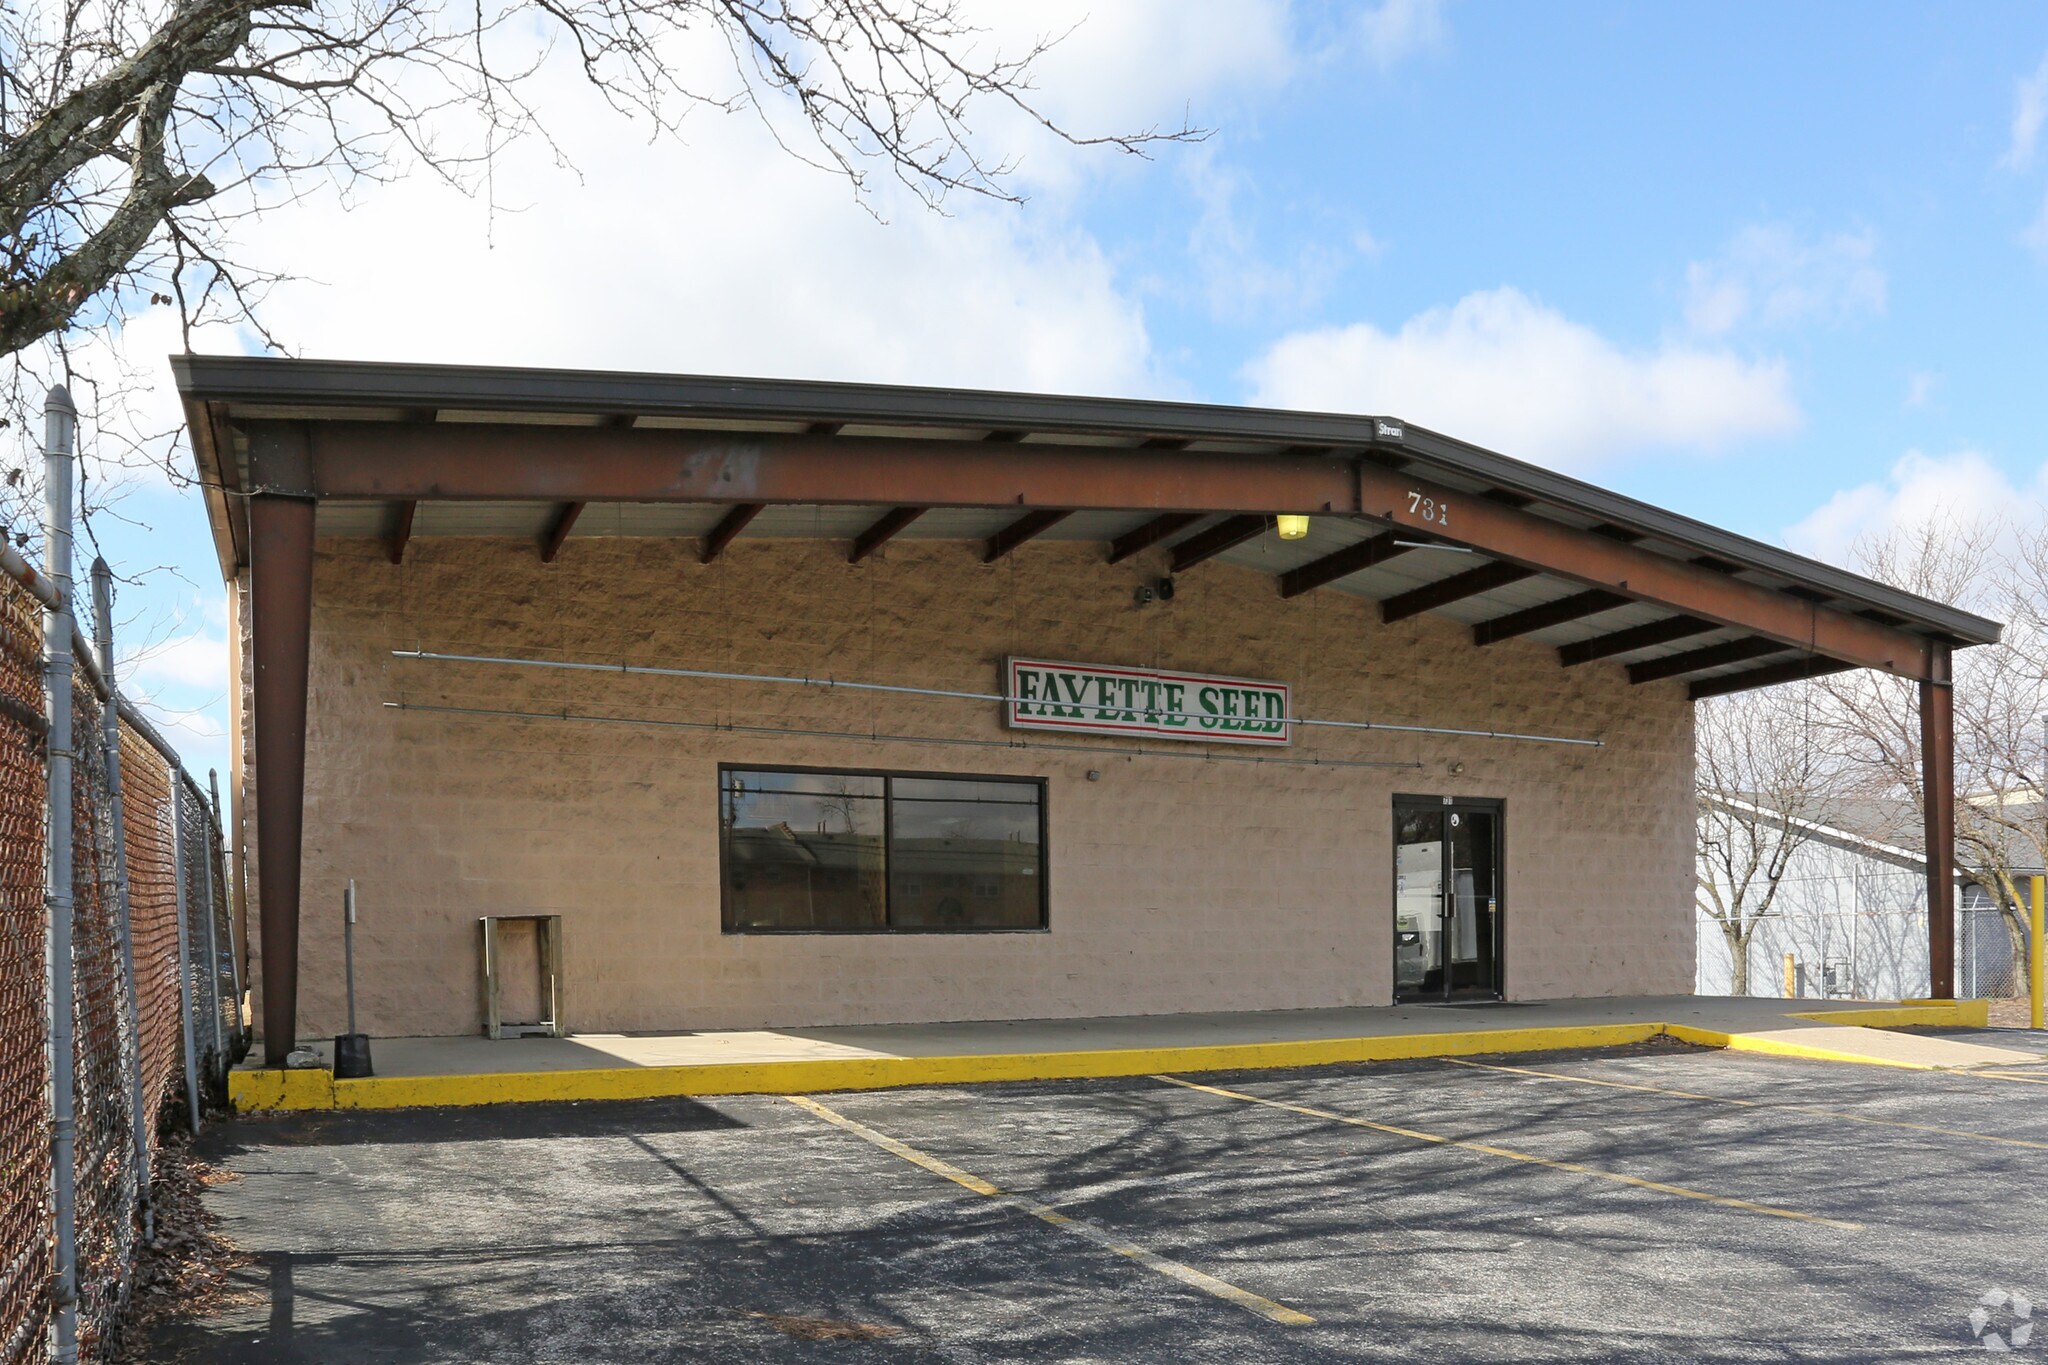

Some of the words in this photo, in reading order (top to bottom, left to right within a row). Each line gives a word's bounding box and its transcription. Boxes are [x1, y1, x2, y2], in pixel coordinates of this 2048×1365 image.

[1408, 491, 1447, 525] 731
[1016, 669, 1188, 727] FAYETTE
[1199, 686, 1284, 733] SEED
